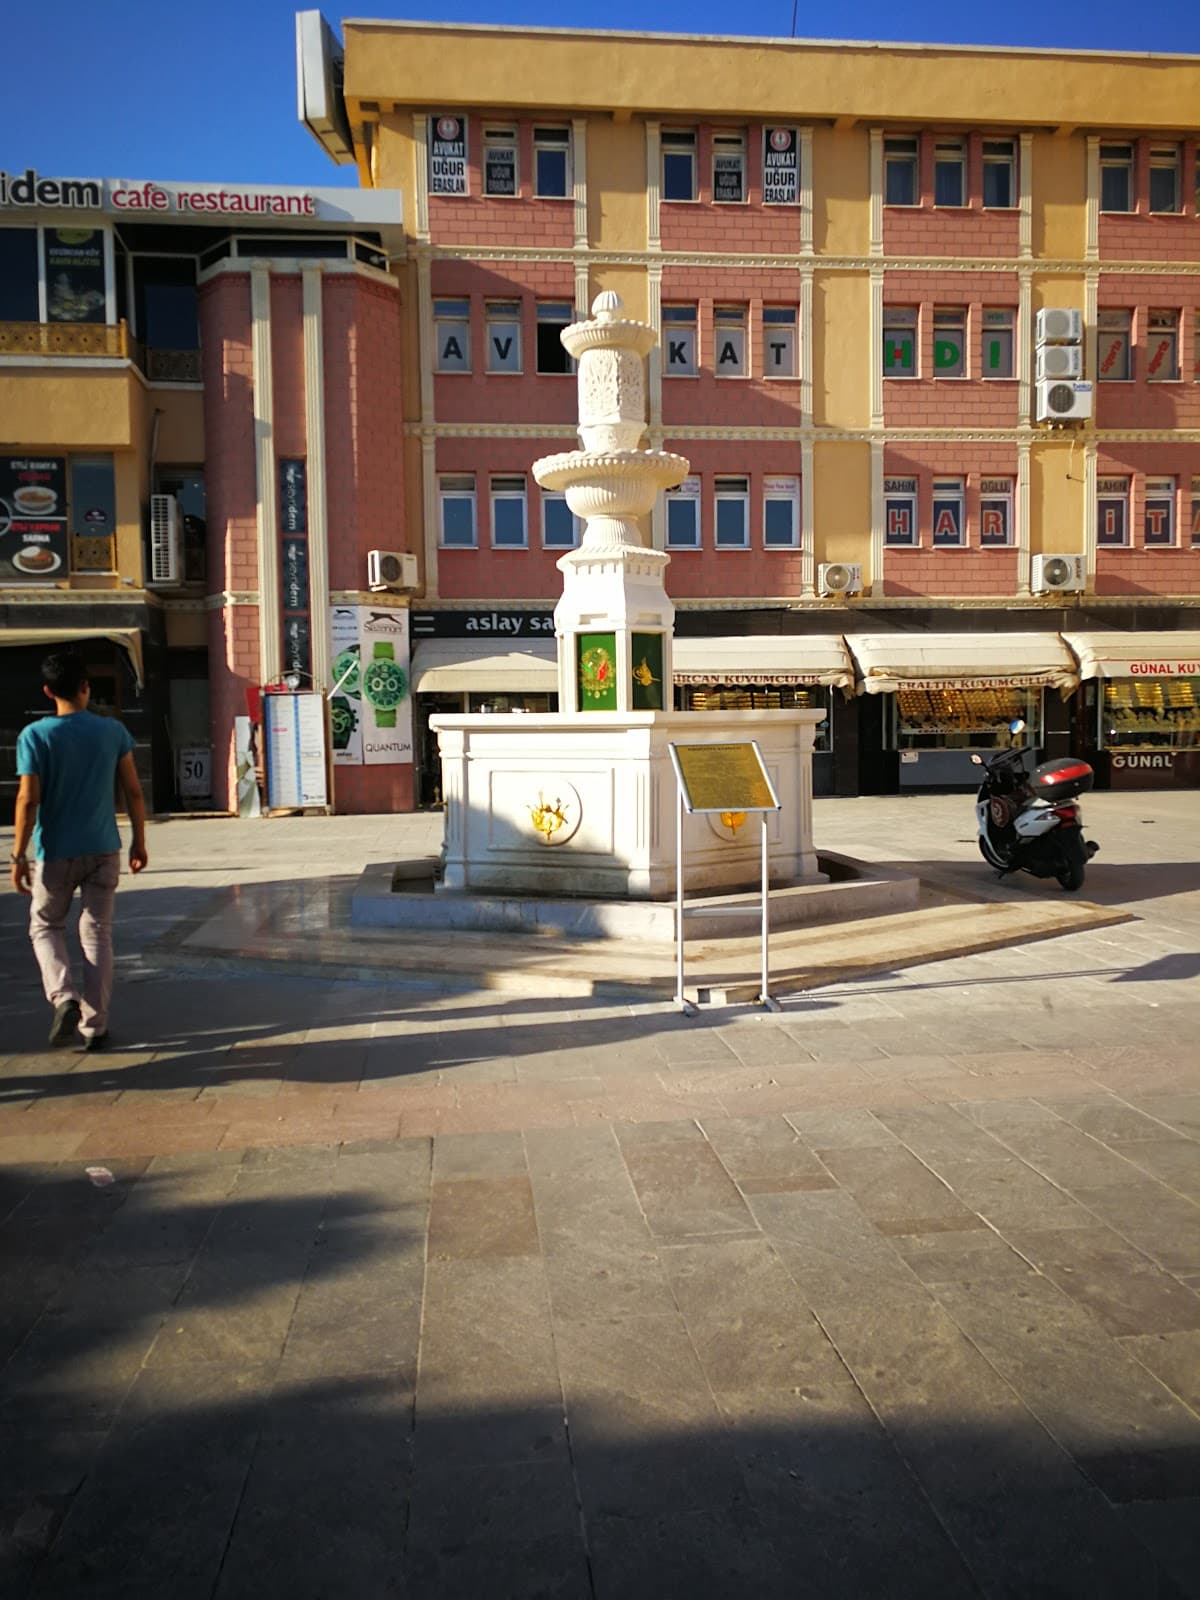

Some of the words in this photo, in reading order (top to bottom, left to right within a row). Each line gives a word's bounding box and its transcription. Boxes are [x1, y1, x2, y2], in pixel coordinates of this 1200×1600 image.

[433, 141, 465, 156] AVUKAT
[433, 157, 465, 176] UĞUR
[766, 152, 796, 166] AVUKAT
[766, 168, 796, 186] UĞUR
[433, 178, 465, 193] ERASLAN
[112, 182, 167, 209] cafe
[177, 191, 314, 216] restaurant
[766, 188, 796, 202] ERASLAN
[465, 612, 523, 634] aslay
[1130, 661, 1175, 674] GÜNAL
[725, 674, 821, 684] KUYUMCULUK
[365, 742, 412, 753] QUANTUM
[1111, 752, 1173, 768] GÜNAL
[184, 760, 204, 780] 50
